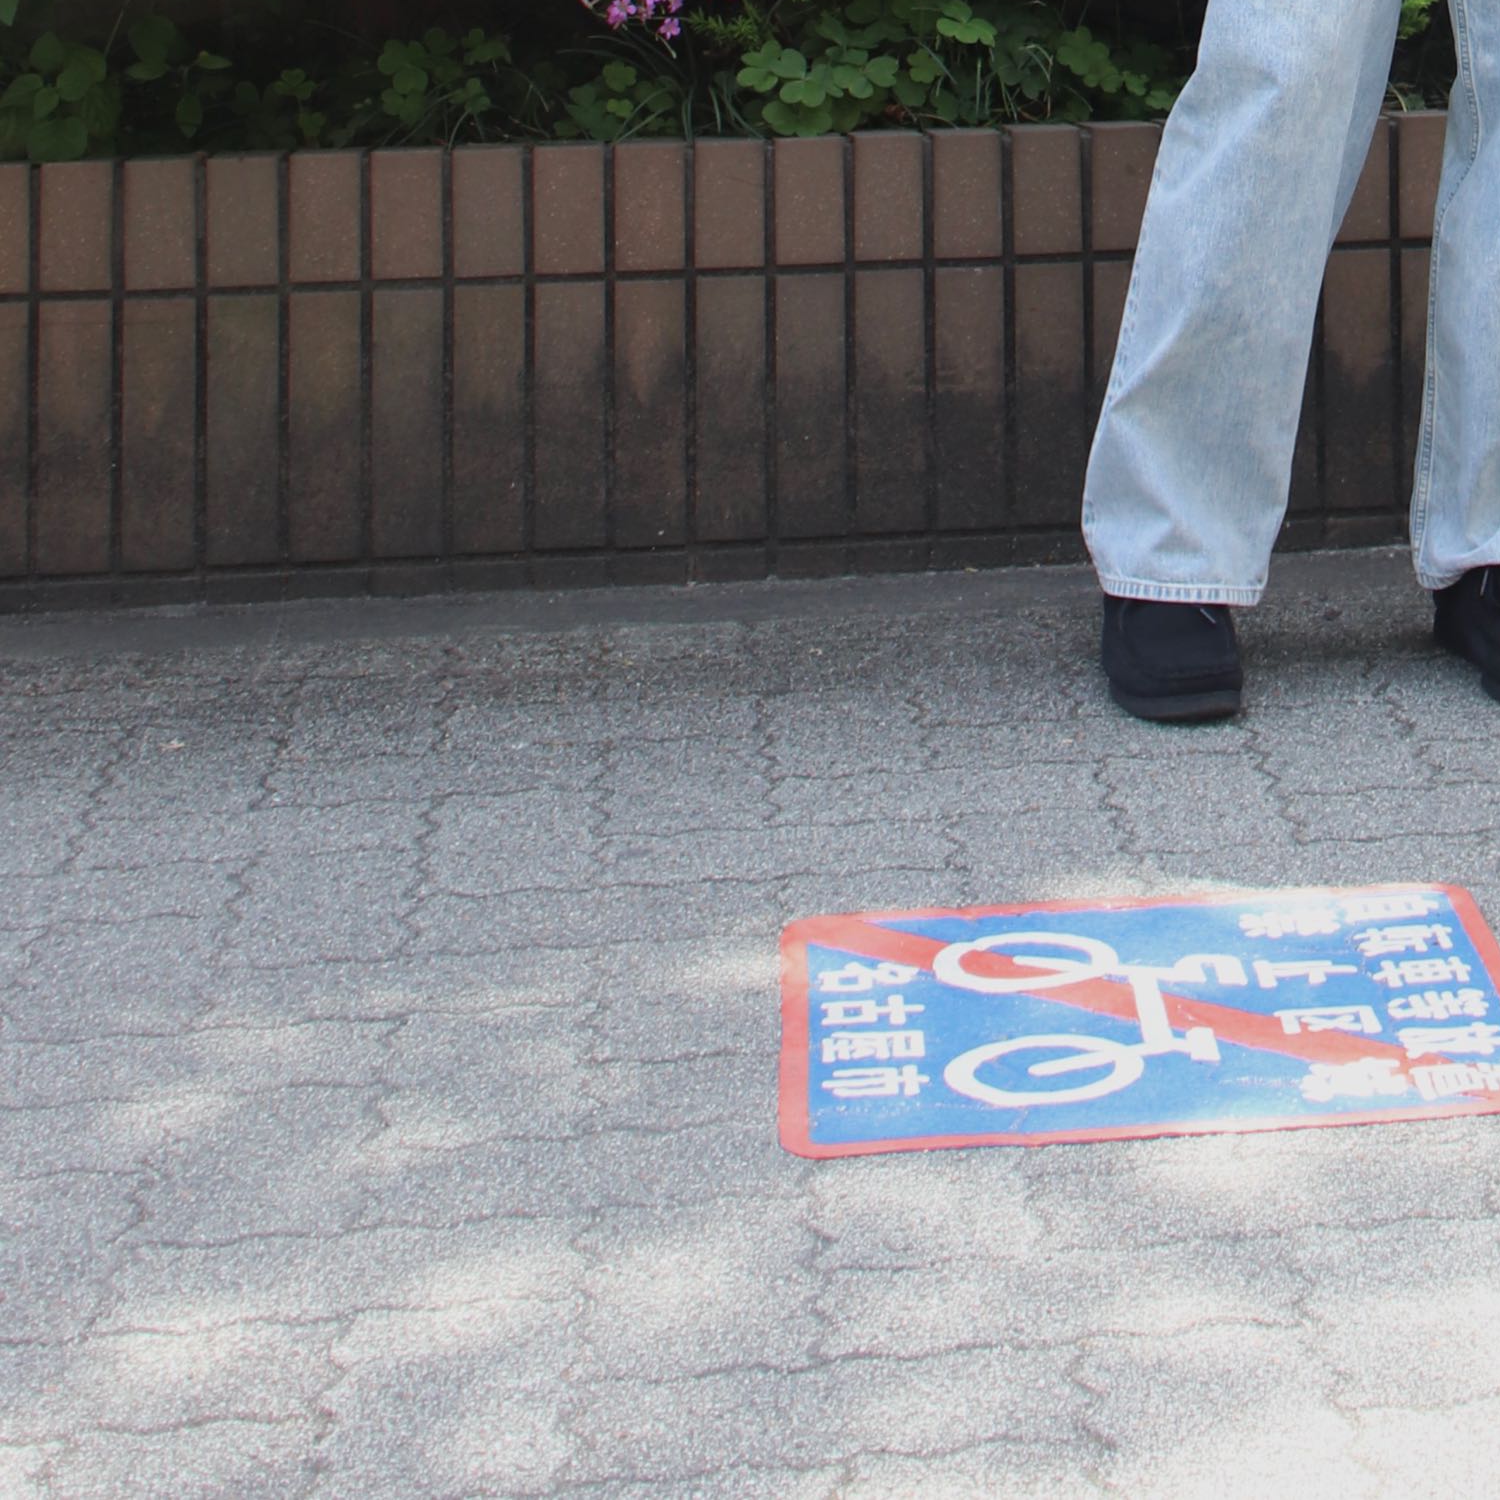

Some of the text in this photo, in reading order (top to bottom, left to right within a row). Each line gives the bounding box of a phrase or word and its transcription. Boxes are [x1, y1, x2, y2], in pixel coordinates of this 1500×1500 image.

[819, 961, 931, 1098] 名古屋市
[1238, 910, 1412, 1102] 禁止区域
